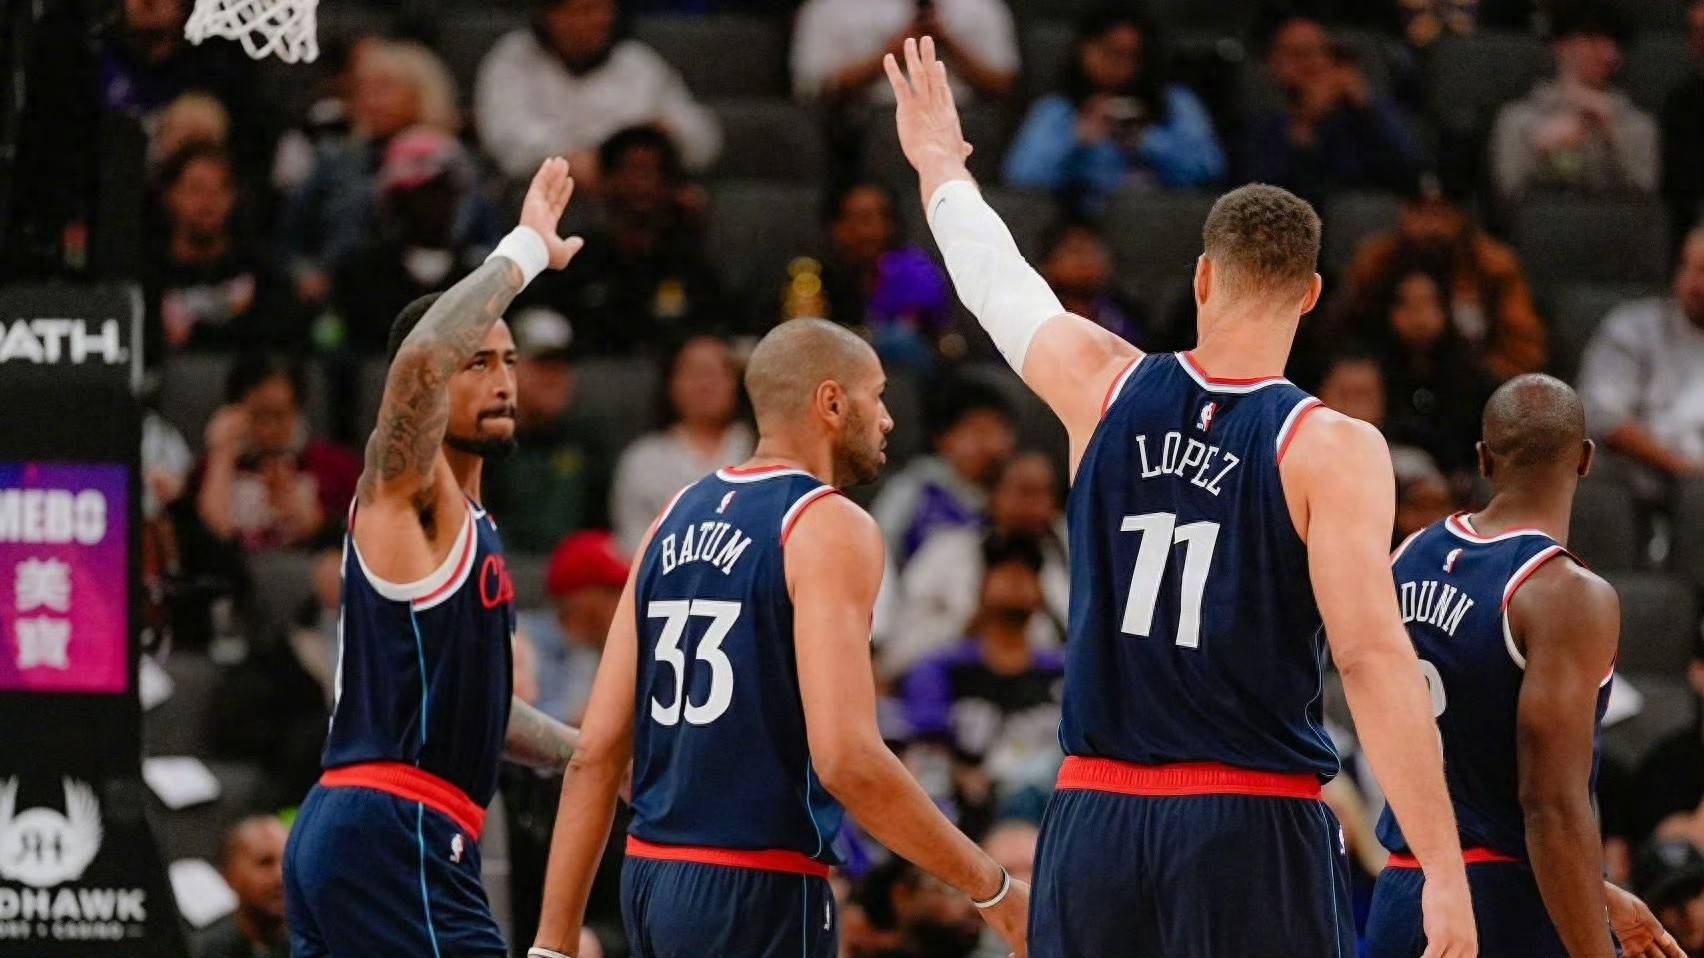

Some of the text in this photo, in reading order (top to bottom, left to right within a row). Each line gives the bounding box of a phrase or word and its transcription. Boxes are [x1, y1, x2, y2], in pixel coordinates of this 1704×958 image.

[1136, 431, 1239, 496] LOPEZ
[662, 521, 752, 576] BATUM
[1120, 511, 1220, 648] 11
[1401, 580, 1474, 637] DUNN
[647, 600, 742, 726] 33
